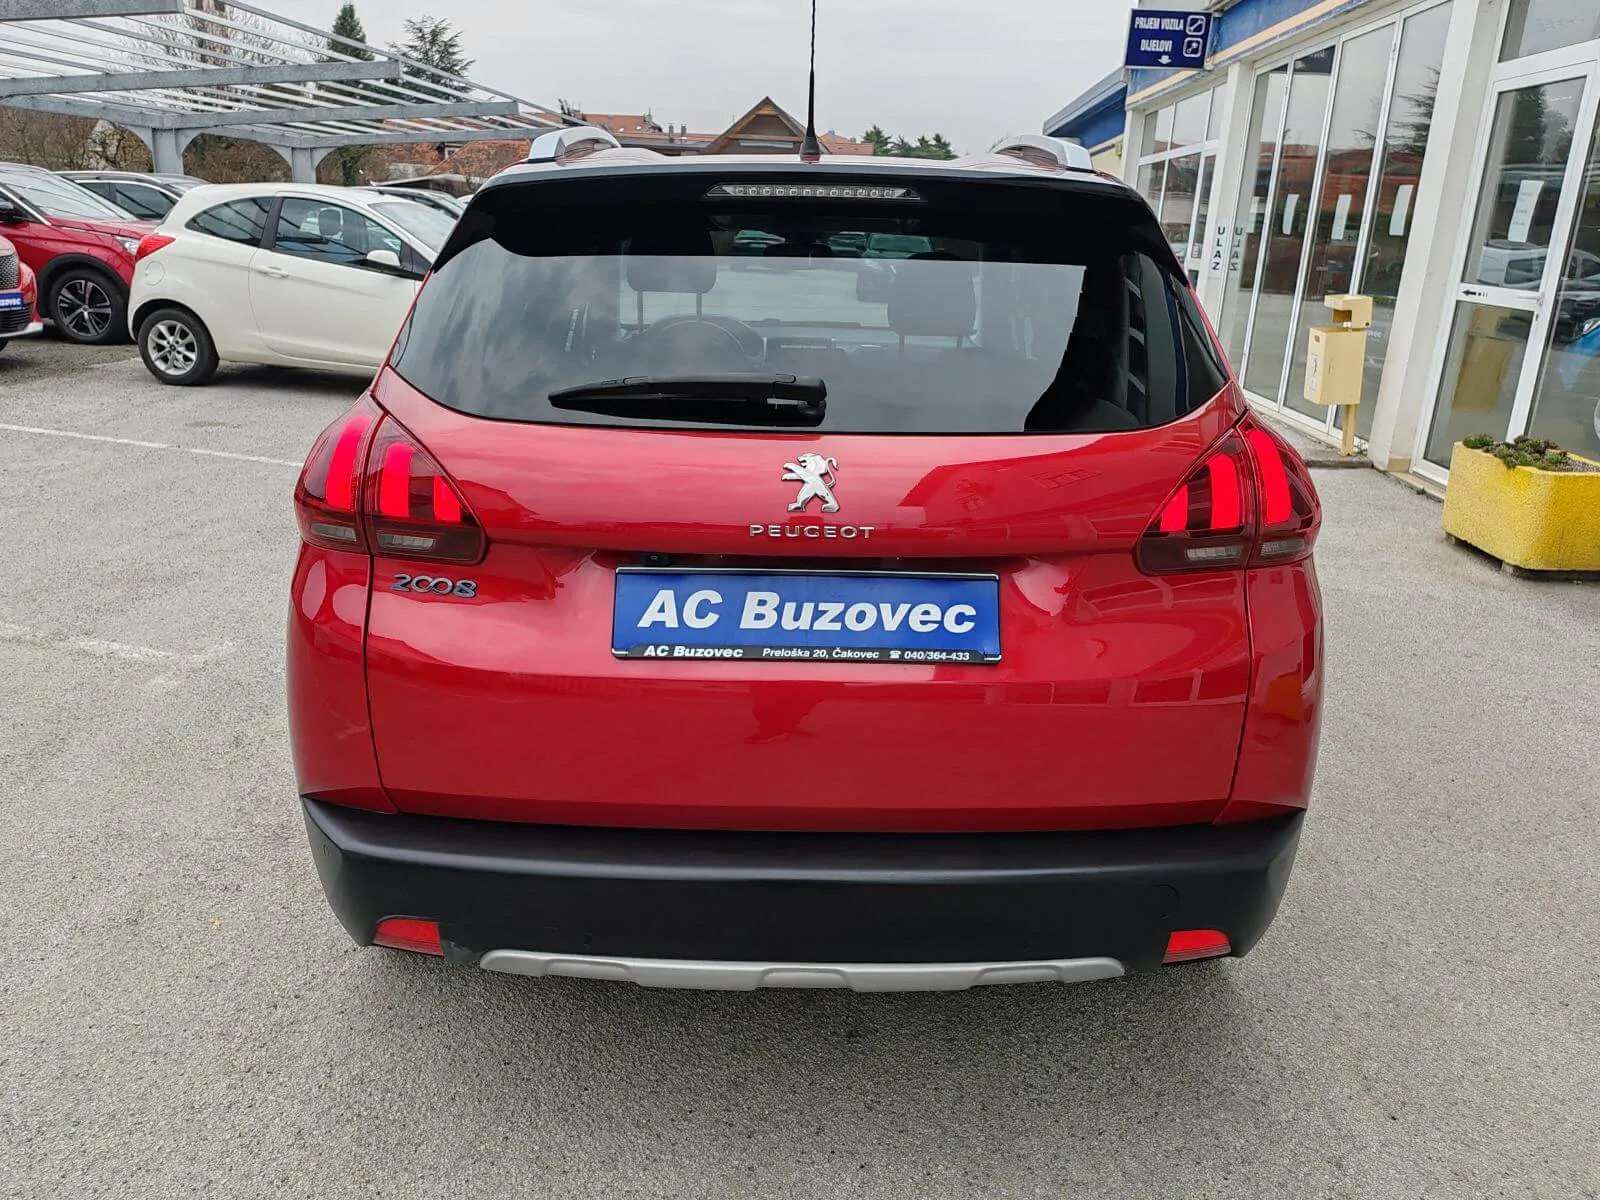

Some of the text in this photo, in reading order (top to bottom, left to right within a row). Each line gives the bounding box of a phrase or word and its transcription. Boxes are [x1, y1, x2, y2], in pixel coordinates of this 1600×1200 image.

[1134, 16, 1184, 31] PRIJEM VOZILA
[1140, 39, 1173, 52] DIJELOVI
[1212, 226, 1226, 270] ULAZ
[749, 524, 875, 539] PEUGEOT
[390, 573, 478, 598] 2008
[637, 589, 977, 634] AC Buzovec
[644, 645, 970, 661] AC Buzovec Preloška 20, Čakovec 040/364-433
